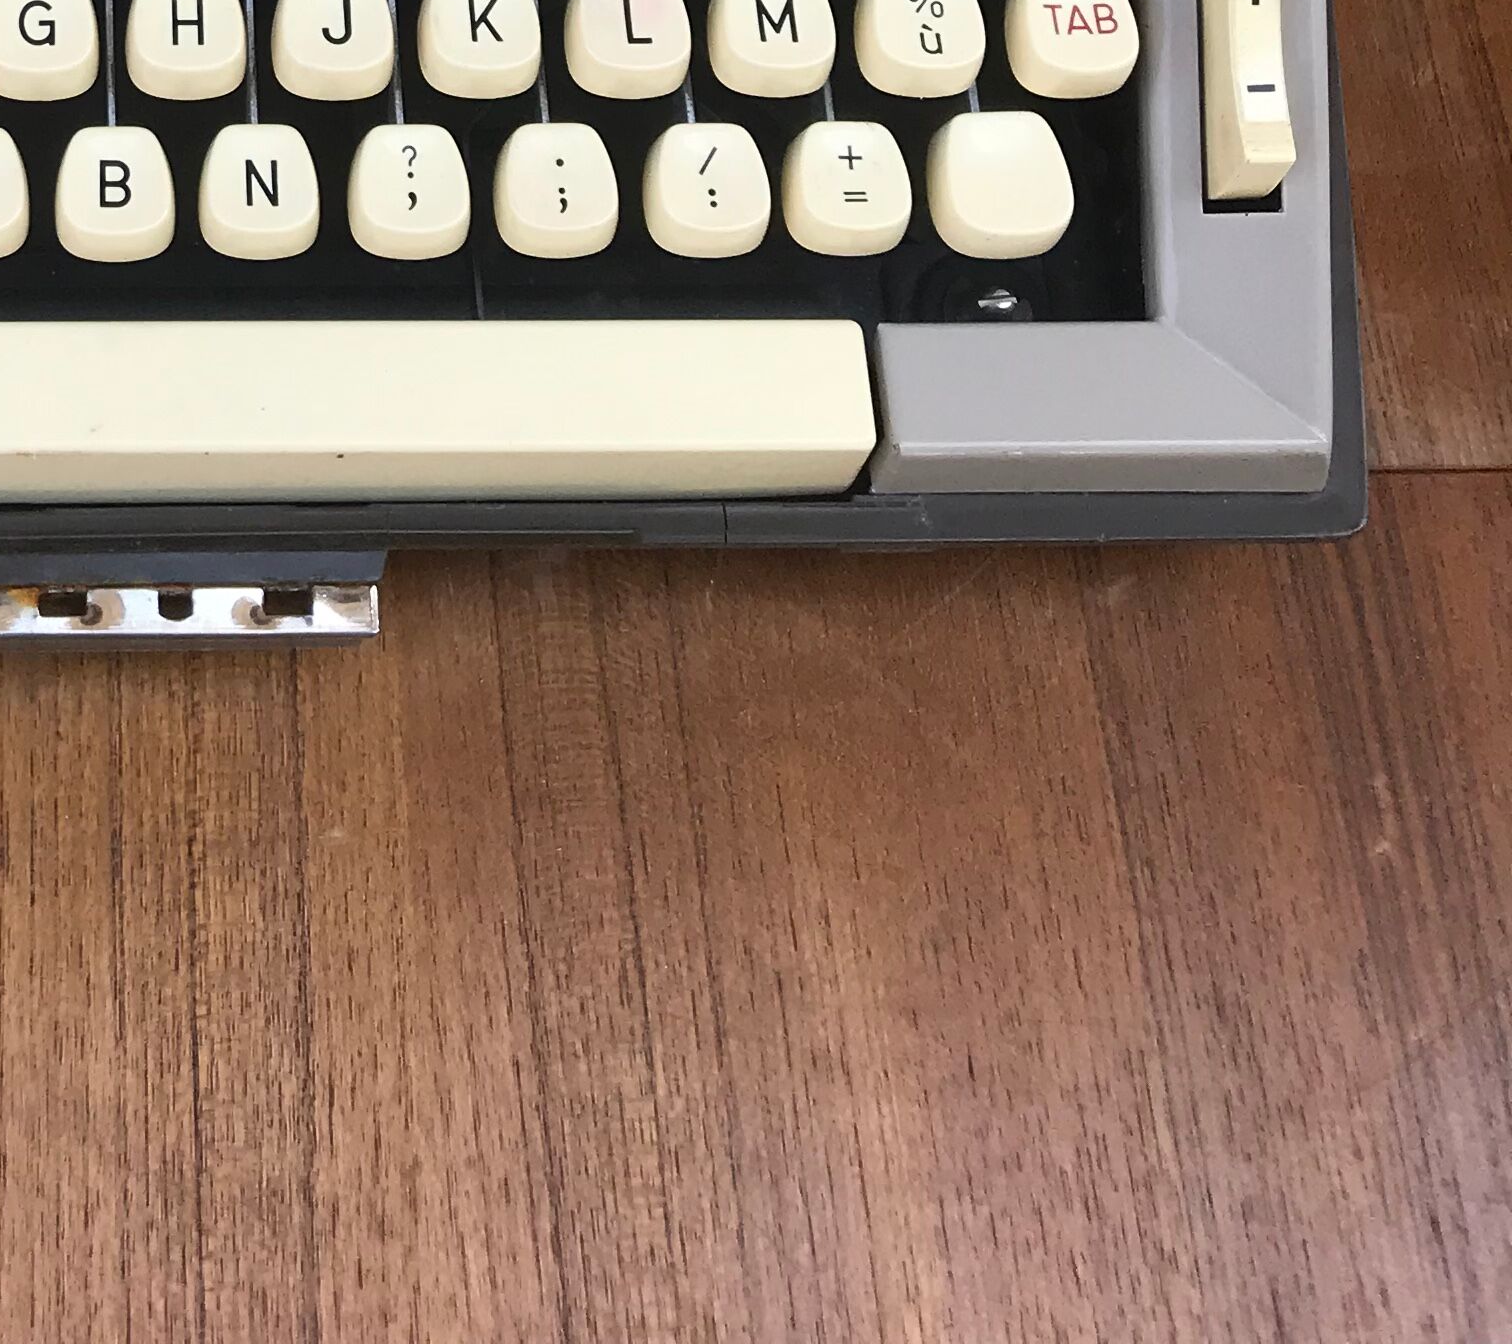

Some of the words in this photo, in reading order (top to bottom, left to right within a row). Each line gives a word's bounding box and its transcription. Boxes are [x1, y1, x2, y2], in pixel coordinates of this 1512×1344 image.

[18, 0, 56, 46] G
[1042, 3, 1119, 35] TAB
[919, 23, 943, 55] ù
[402, 145, 417, 179] ?
[838, 145, 863, 170] +
[99, 159, 132, 208] B
[245, 159, 279, 207] N
